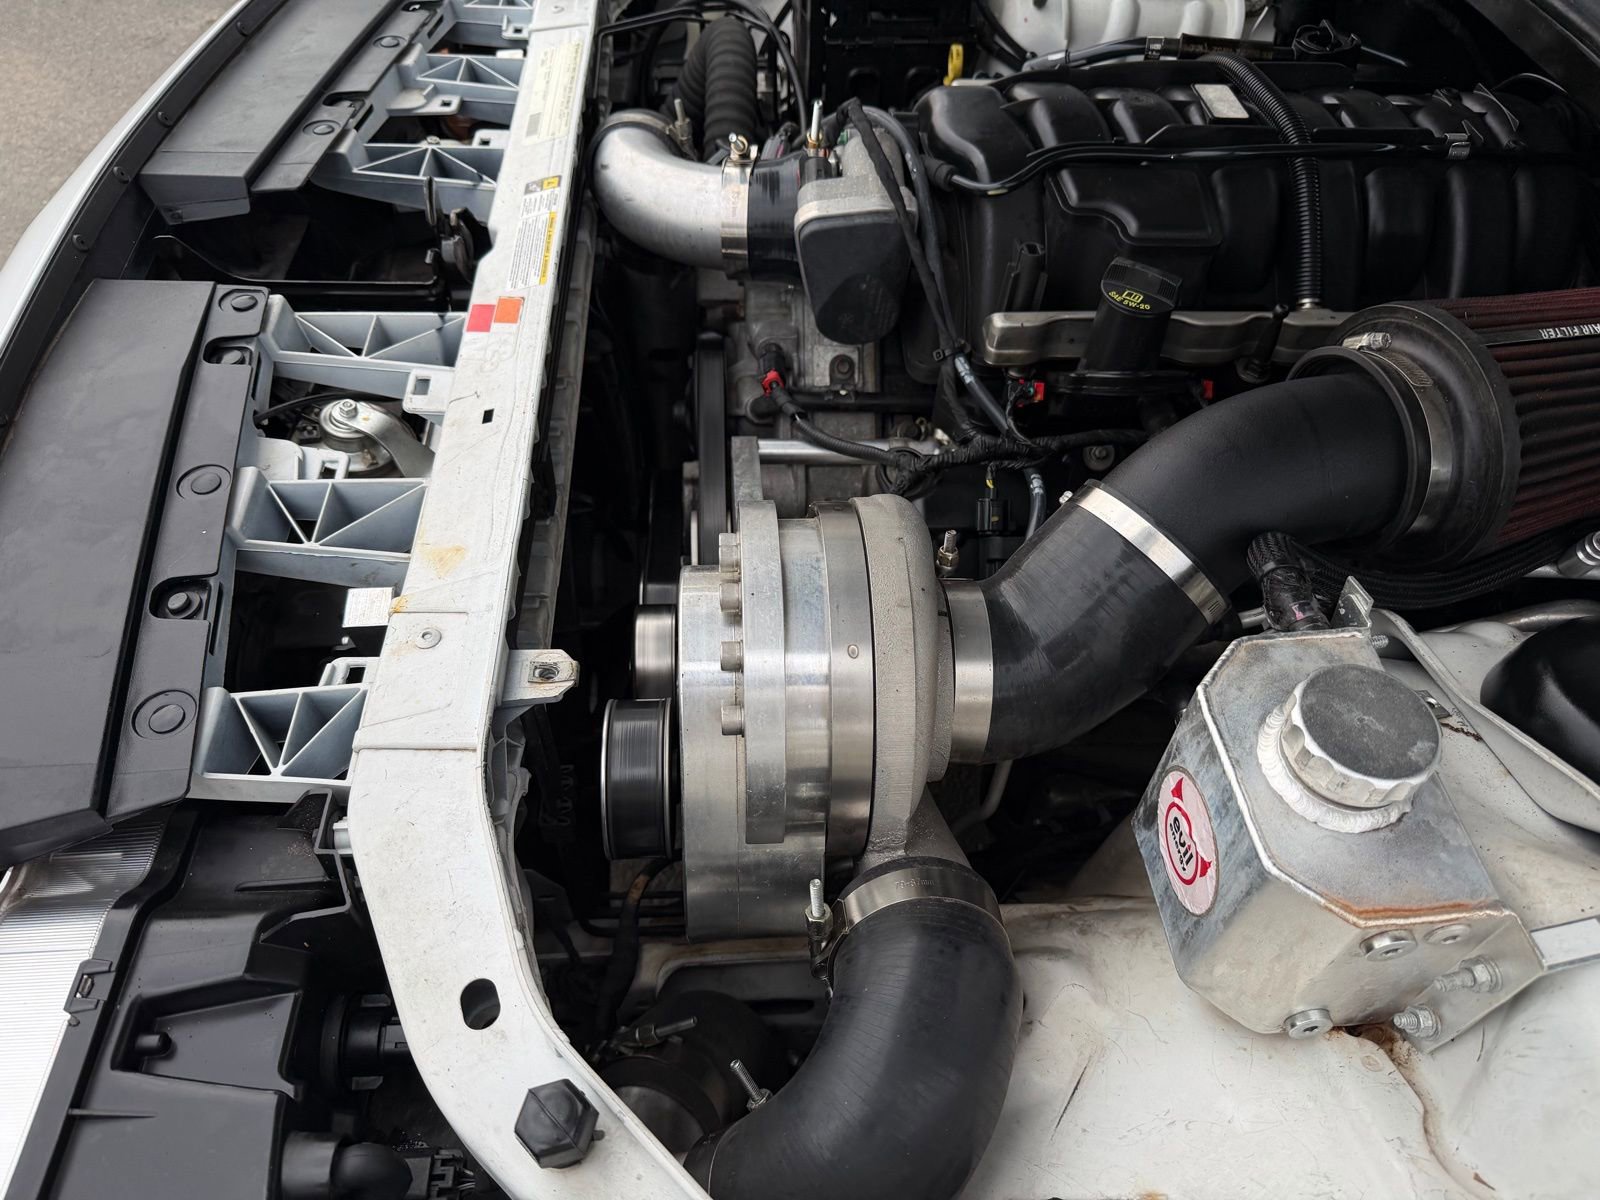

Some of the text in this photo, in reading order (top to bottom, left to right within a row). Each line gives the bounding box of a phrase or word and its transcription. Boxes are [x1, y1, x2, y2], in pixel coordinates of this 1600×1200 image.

[1109, 291, 1151, 310] SAE 5W-20
[1539, 323, 1600, 339] AIR FILTER
[1173, 816, 1194, 867] evil
